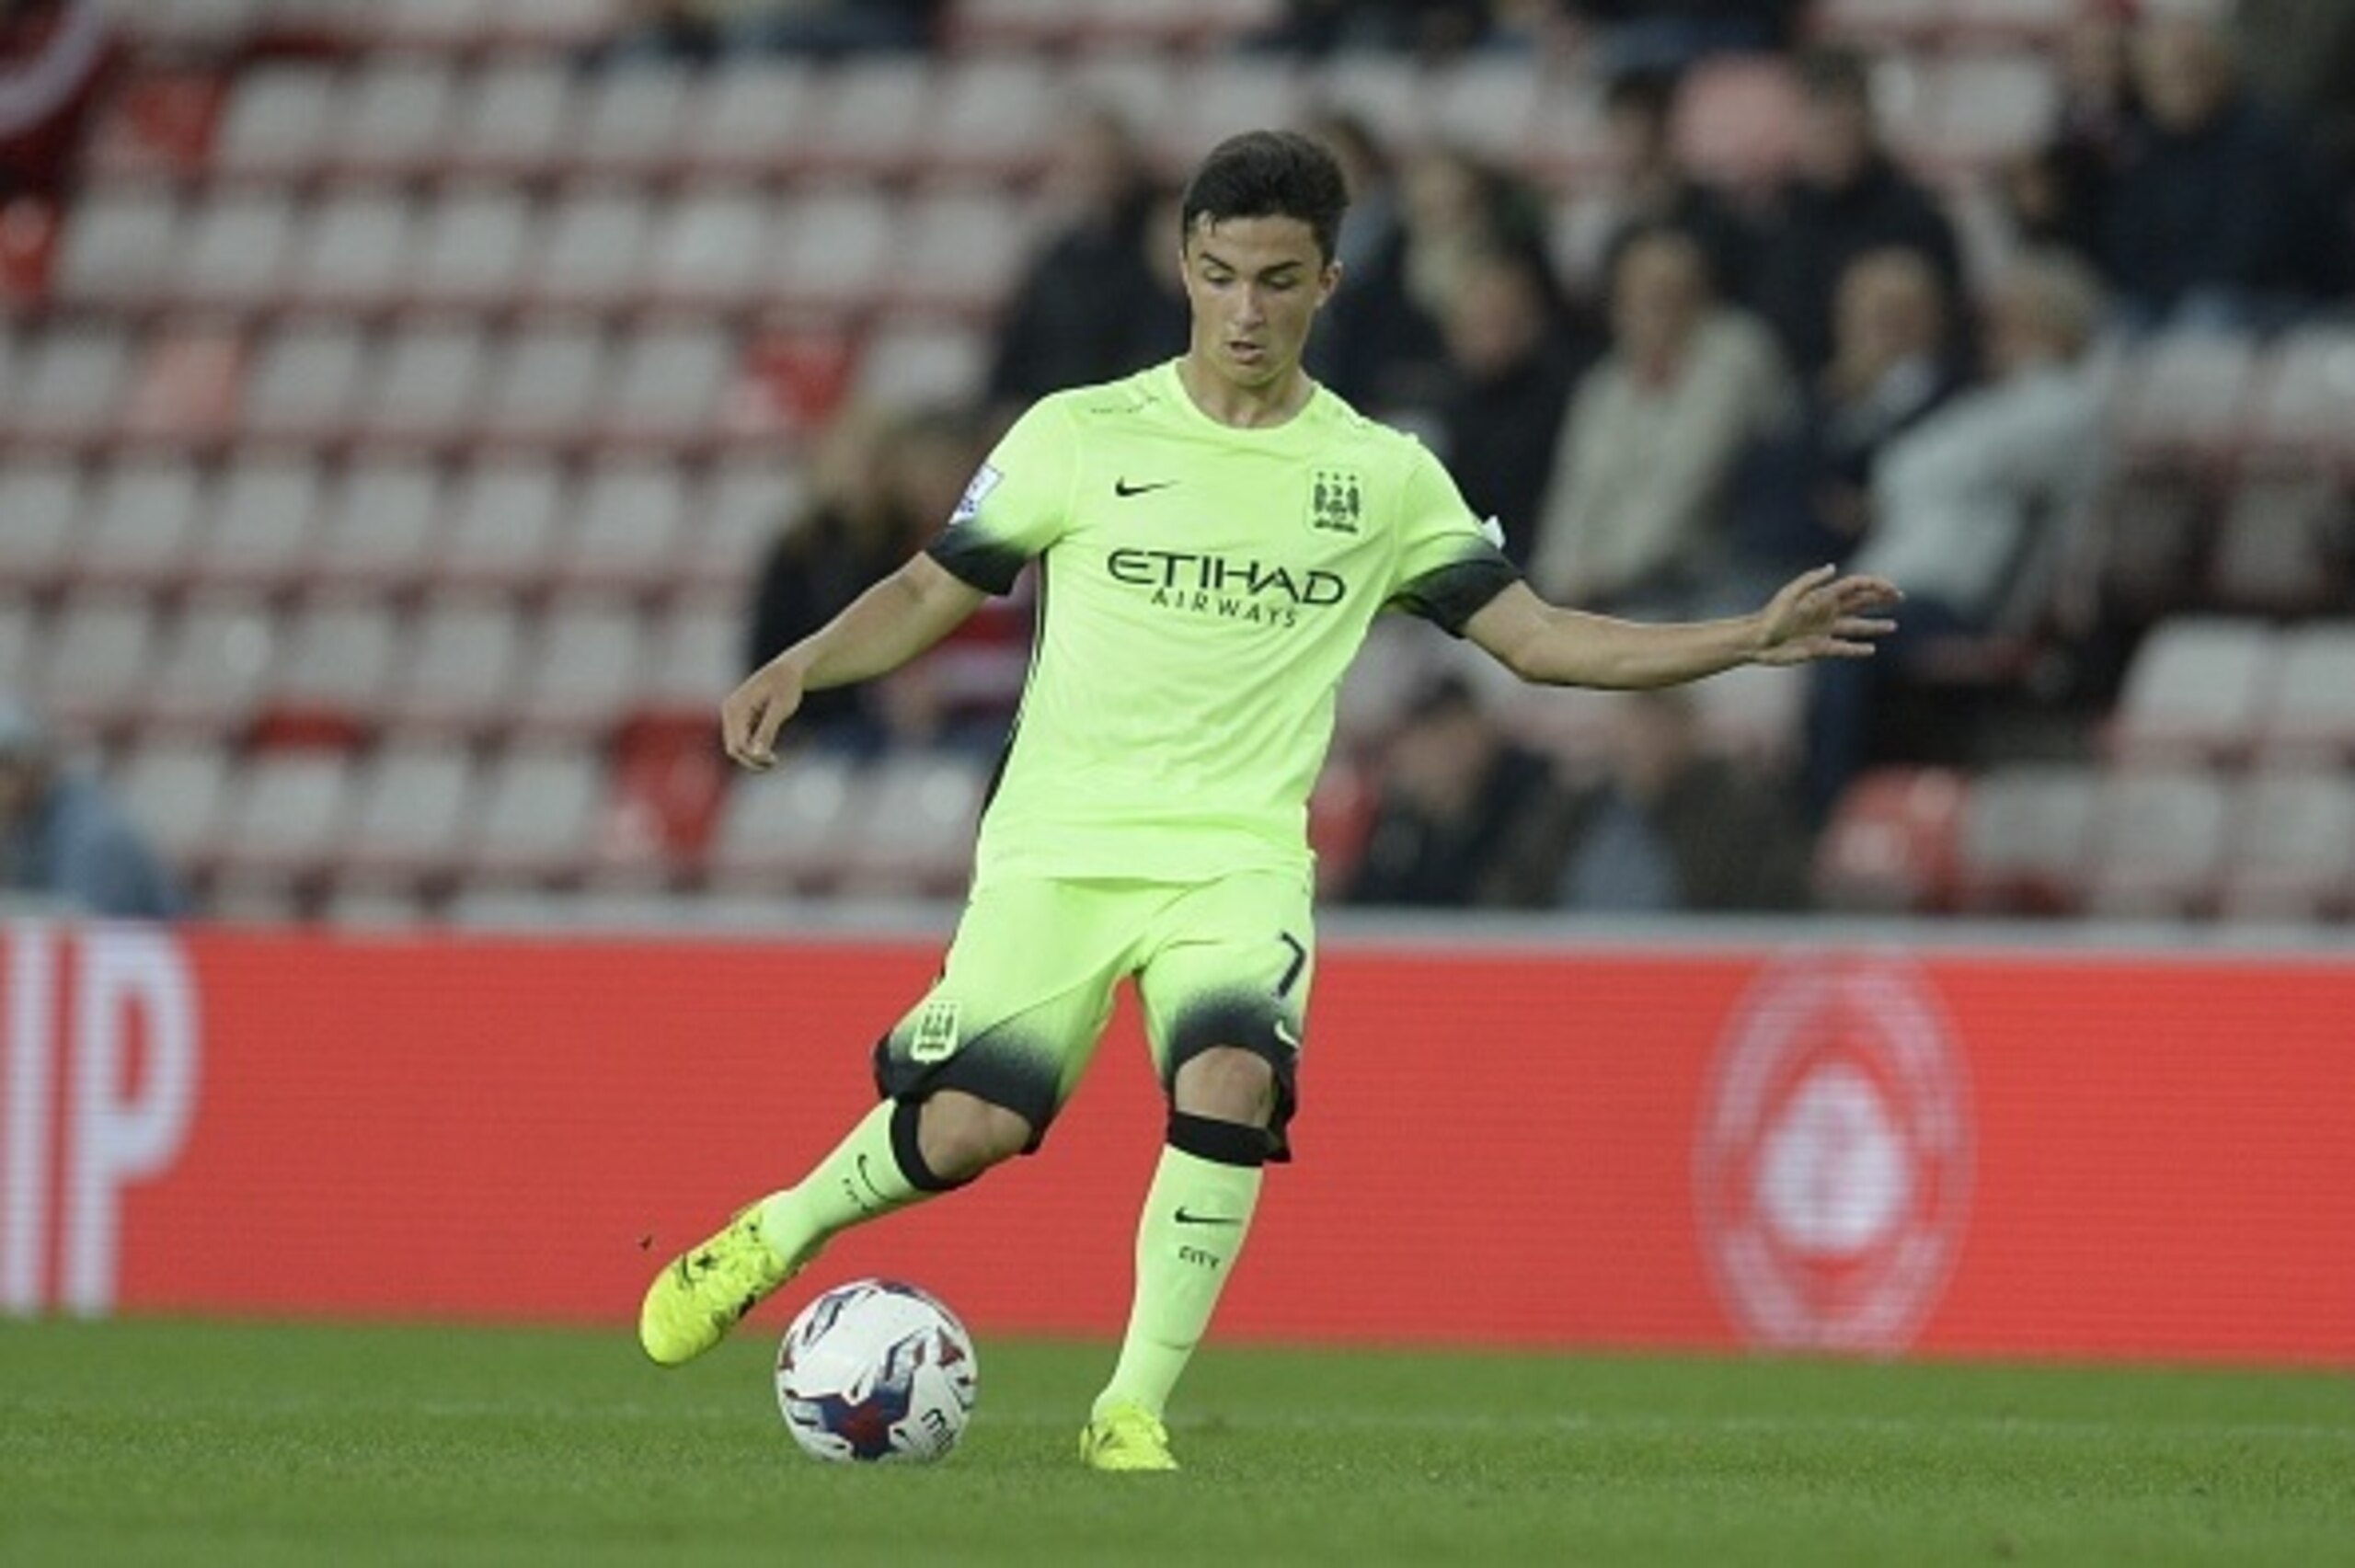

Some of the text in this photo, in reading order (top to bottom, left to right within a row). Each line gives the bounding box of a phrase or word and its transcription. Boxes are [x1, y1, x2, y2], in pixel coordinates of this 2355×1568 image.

[1108, 548, 1347, 604] ETIHAD
[1151, 587, 1296, 627] AIRWAYS
[1278, 932, 1306, 998] 7
[1178, 1245, 1220, 1269] CITY
